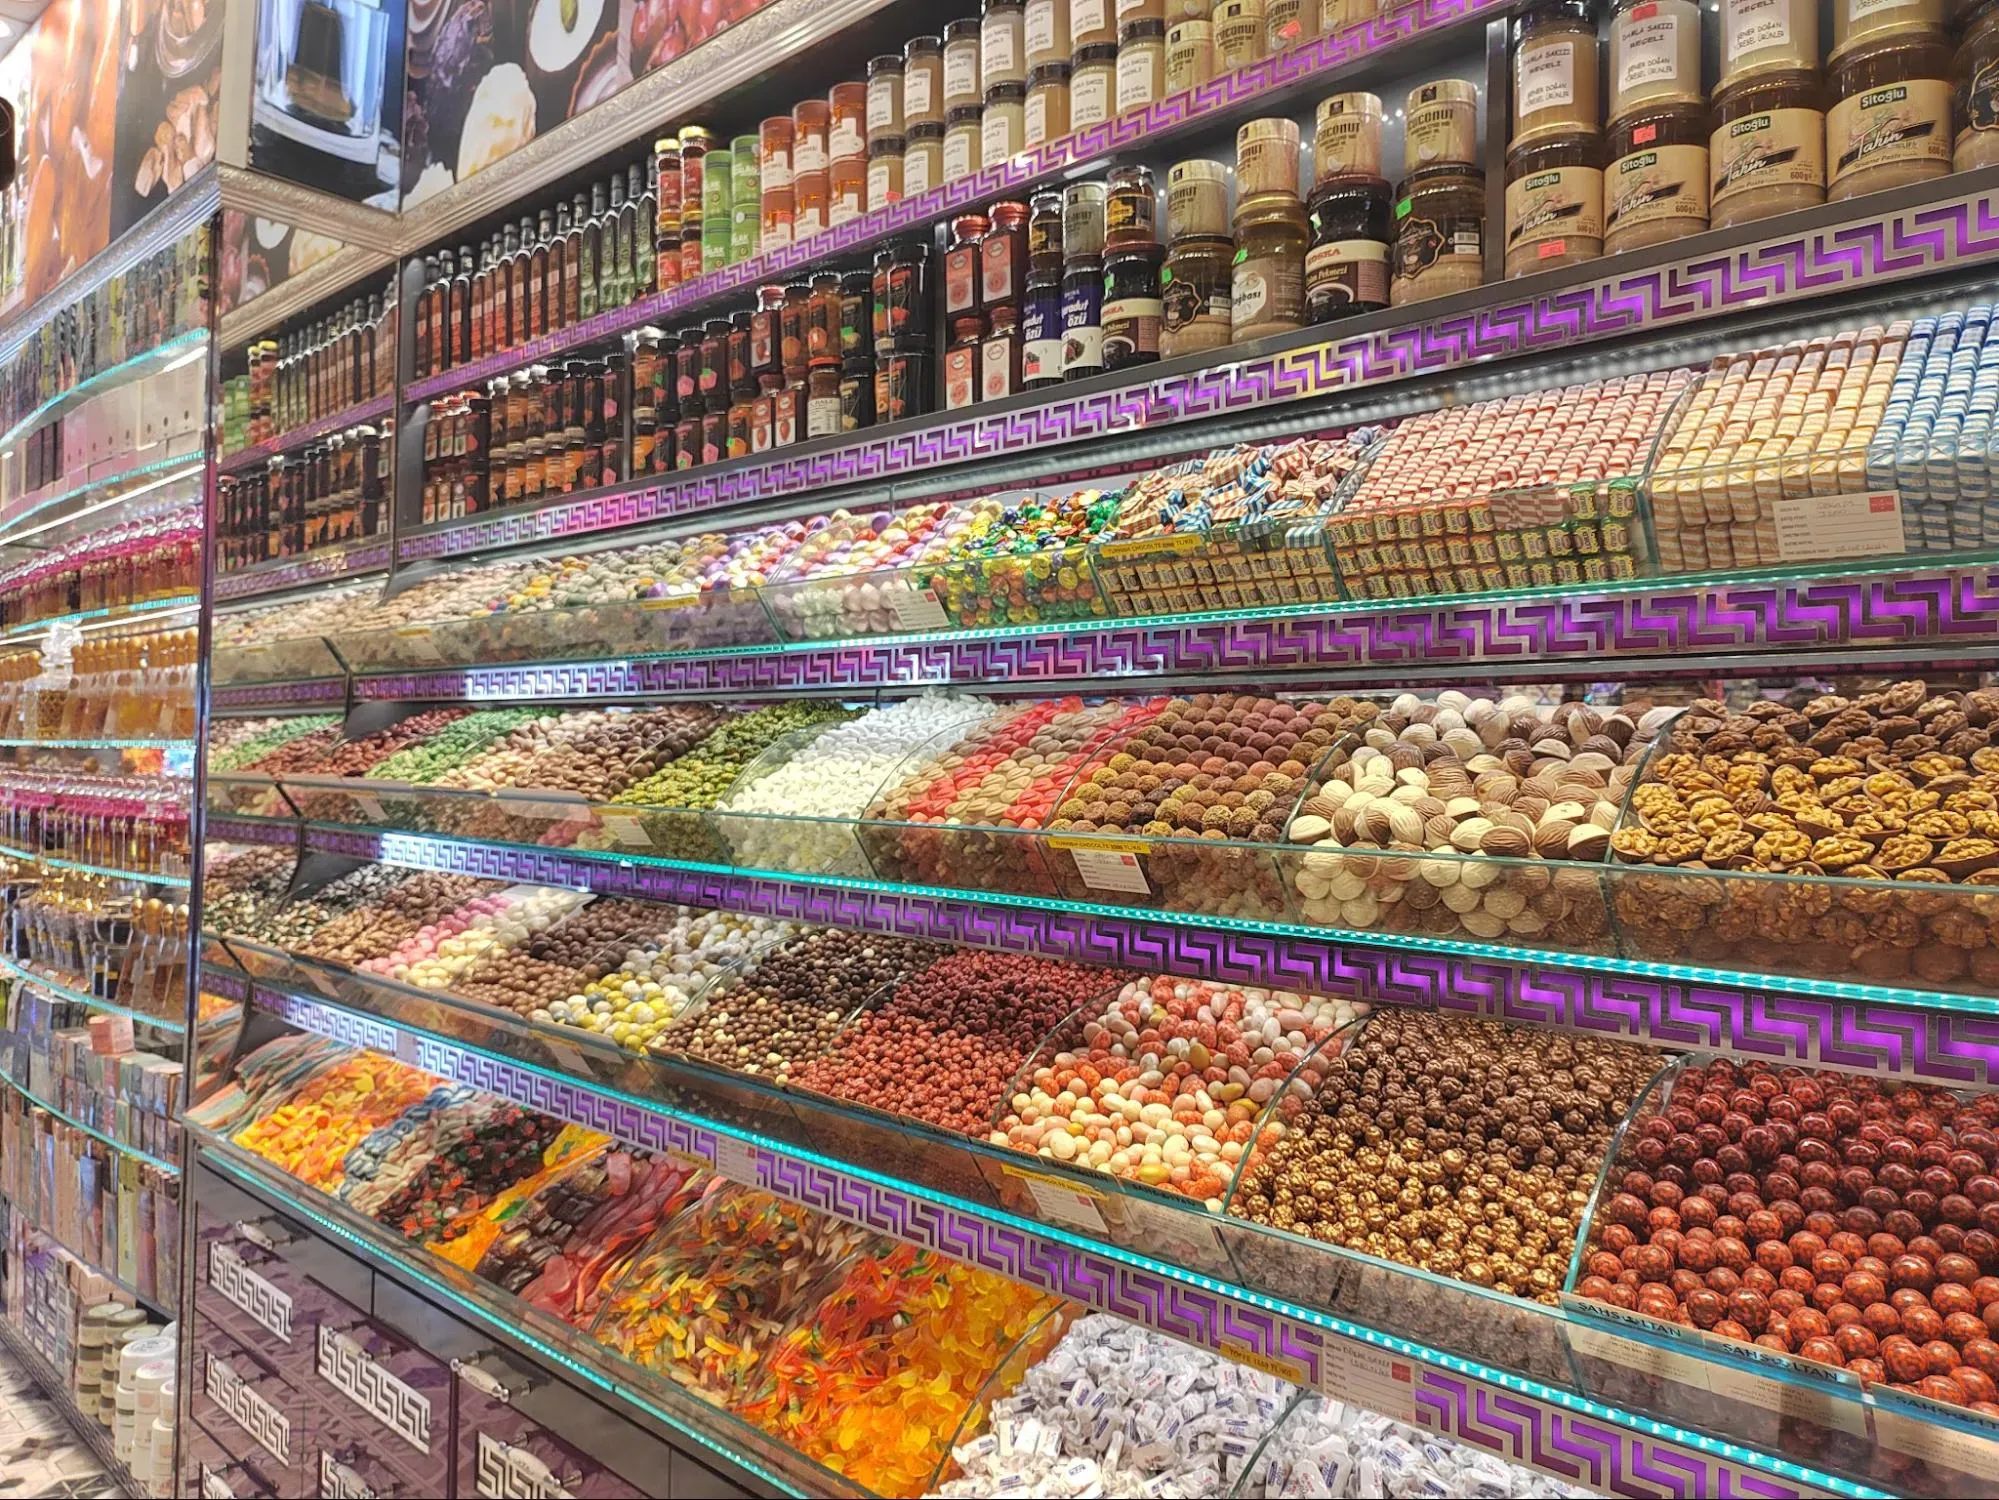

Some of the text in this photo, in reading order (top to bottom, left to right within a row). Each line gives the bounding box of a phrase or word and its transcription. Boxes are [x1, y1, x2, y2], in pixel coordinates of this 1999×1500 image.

[1850, 123, 1904, 160] Tahin
[1721, 152, 1767, 186] Tahin
[1516, 201, 1557, 235] Tahin
[1614, 184, 1654, 219] Tahin
